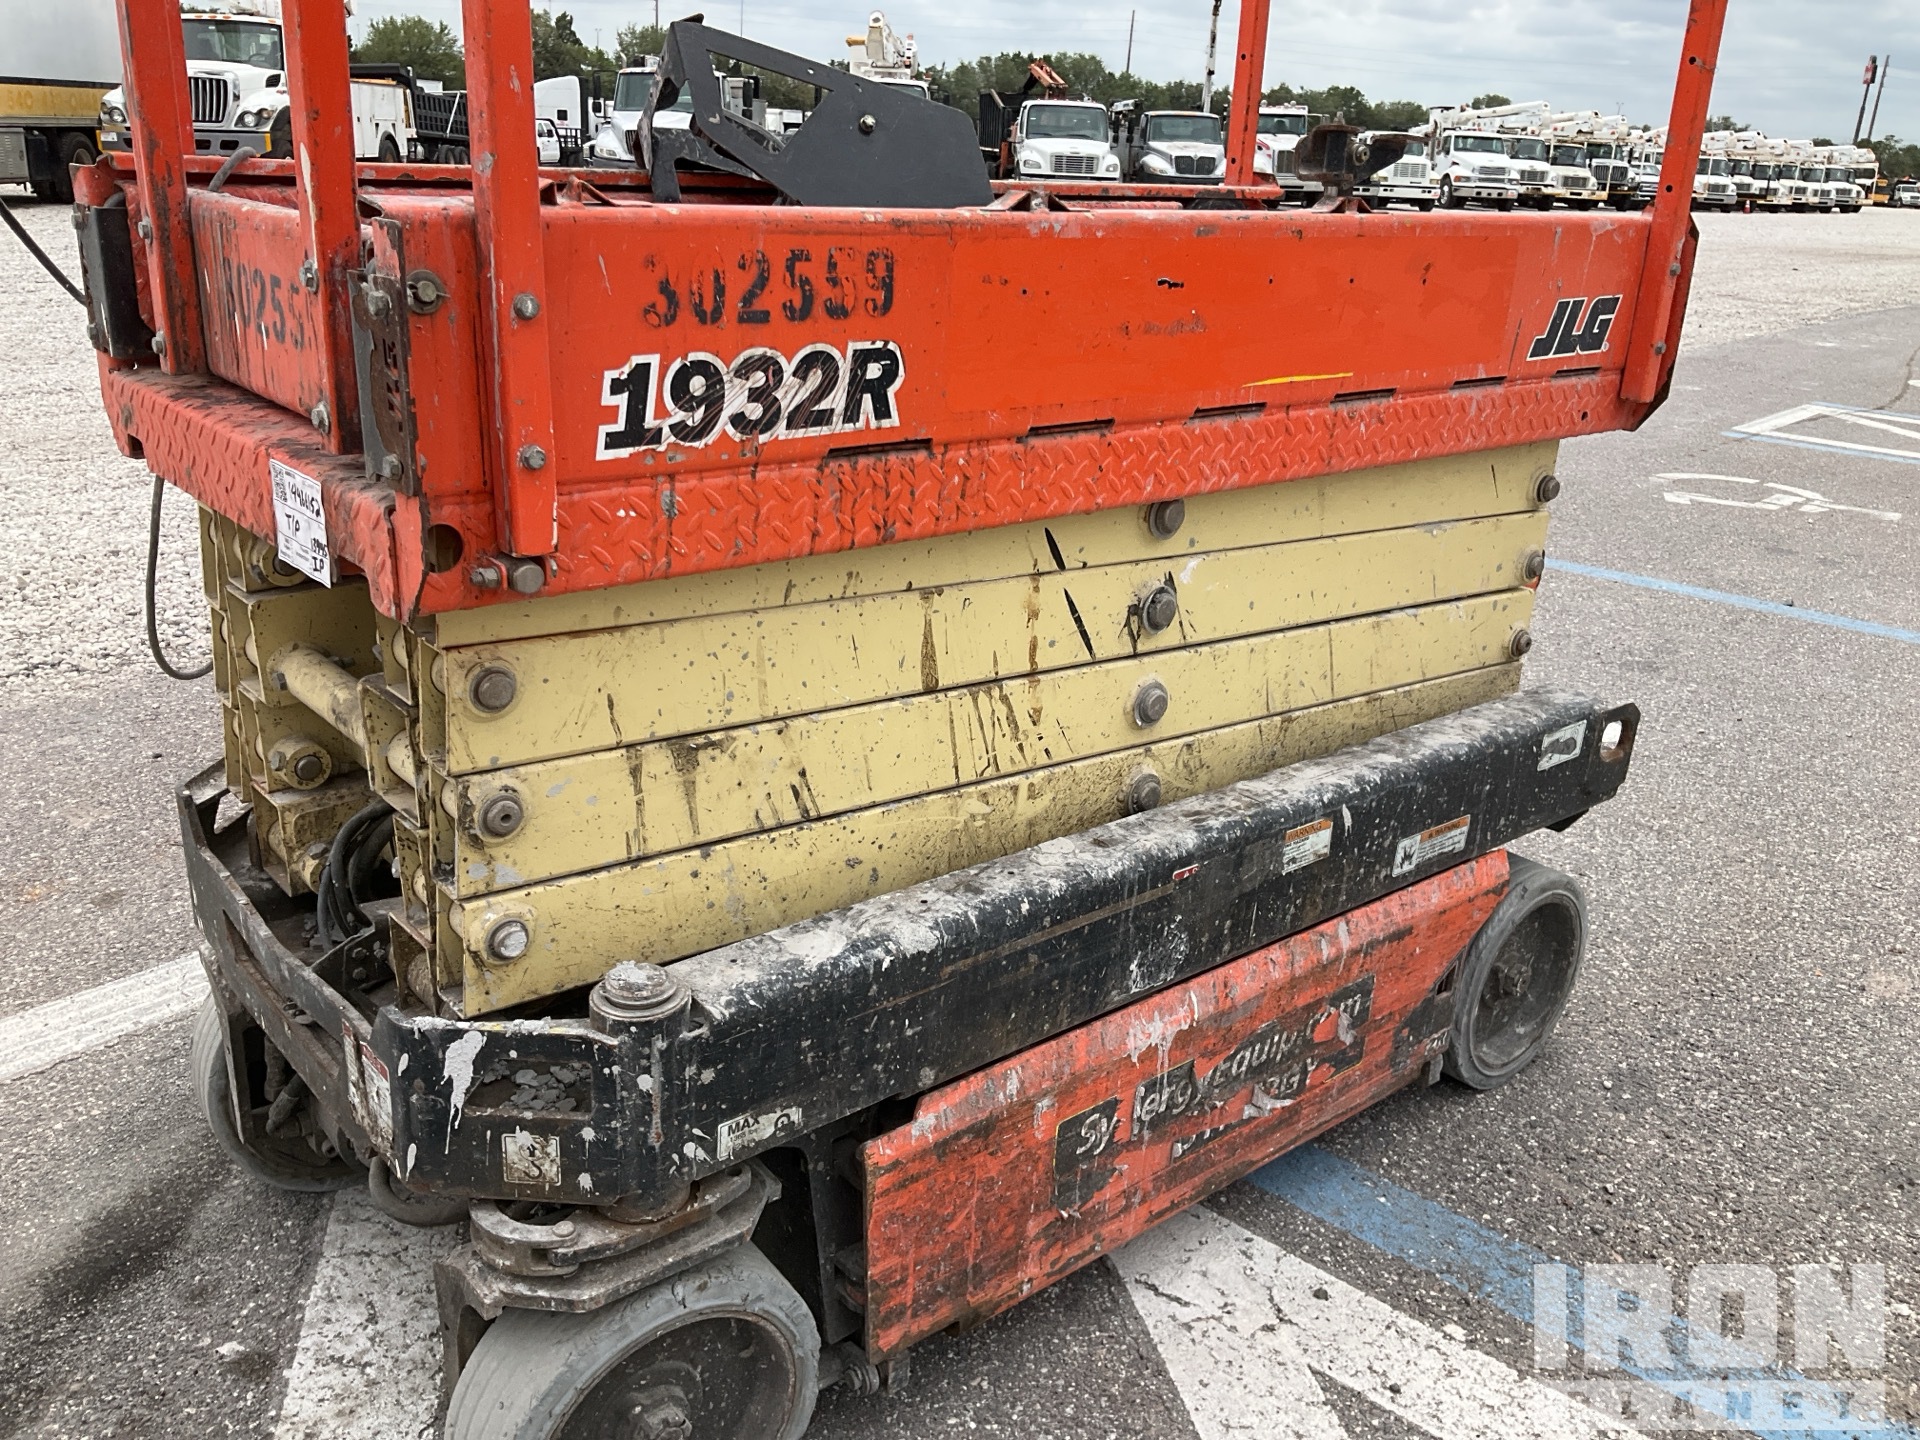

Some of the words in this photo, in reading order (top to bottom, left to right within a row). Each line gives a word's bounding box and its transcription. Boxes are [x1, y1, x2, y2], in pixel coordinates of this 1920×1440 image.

[643, 246, 894, 327] 302559
[1526, 294, 1623, 361] JLG
[596, 341, 904, 459] 1932R
[1287, 821, 1322, 843] WARNING
[727, 1118, 760, 1136] MAX
